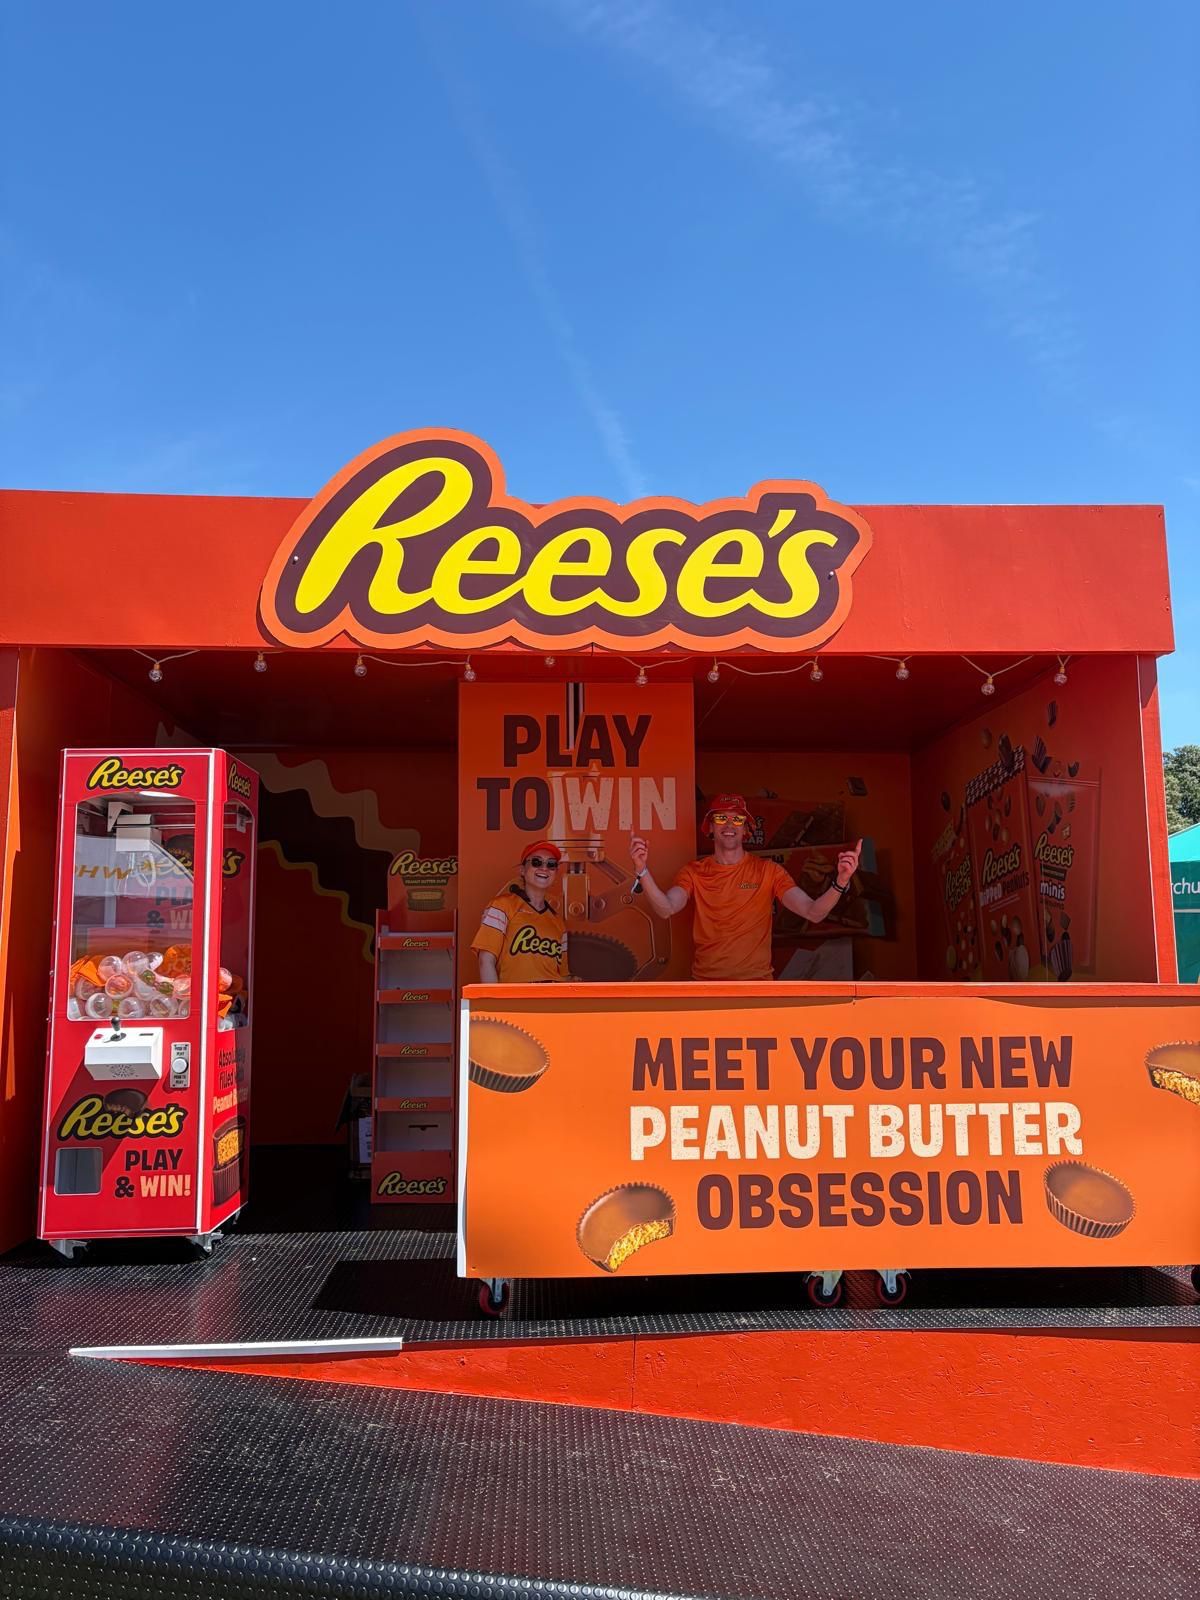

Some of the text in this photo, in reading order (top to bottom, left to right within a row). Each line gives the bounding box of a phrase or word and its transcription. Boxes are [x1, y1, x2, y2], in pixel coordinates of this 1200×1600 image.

[295, 456, 838, 618] Reese's
[503, 714, 652, 767] PLAY
[88, 758, 182, 787] Reese's
[228, 763, 250, 796] Reese's
[476, 776, 677, 831] TO WIN
[391, 853, 458, 875] Reese's
[982, 845, 1021, 885] Reese's
[1035, 833, 1074, 867] Reese's
[1040, 880, 1065, 900] minis
[631, 1035, 1073, 1092] MEET YOUR NEW
[60, 1097, 184, 1138] Reese's
[629, 1101, 1084, 1161] PEANUT BUTTER
[125, 1149, 183, 1171] PLAY
[114, 1174, 191, 1198] & WIN!
[378, 1172, 446, 1195] Reese's
[697, 1169, 1024, 1230] OBSESSION
